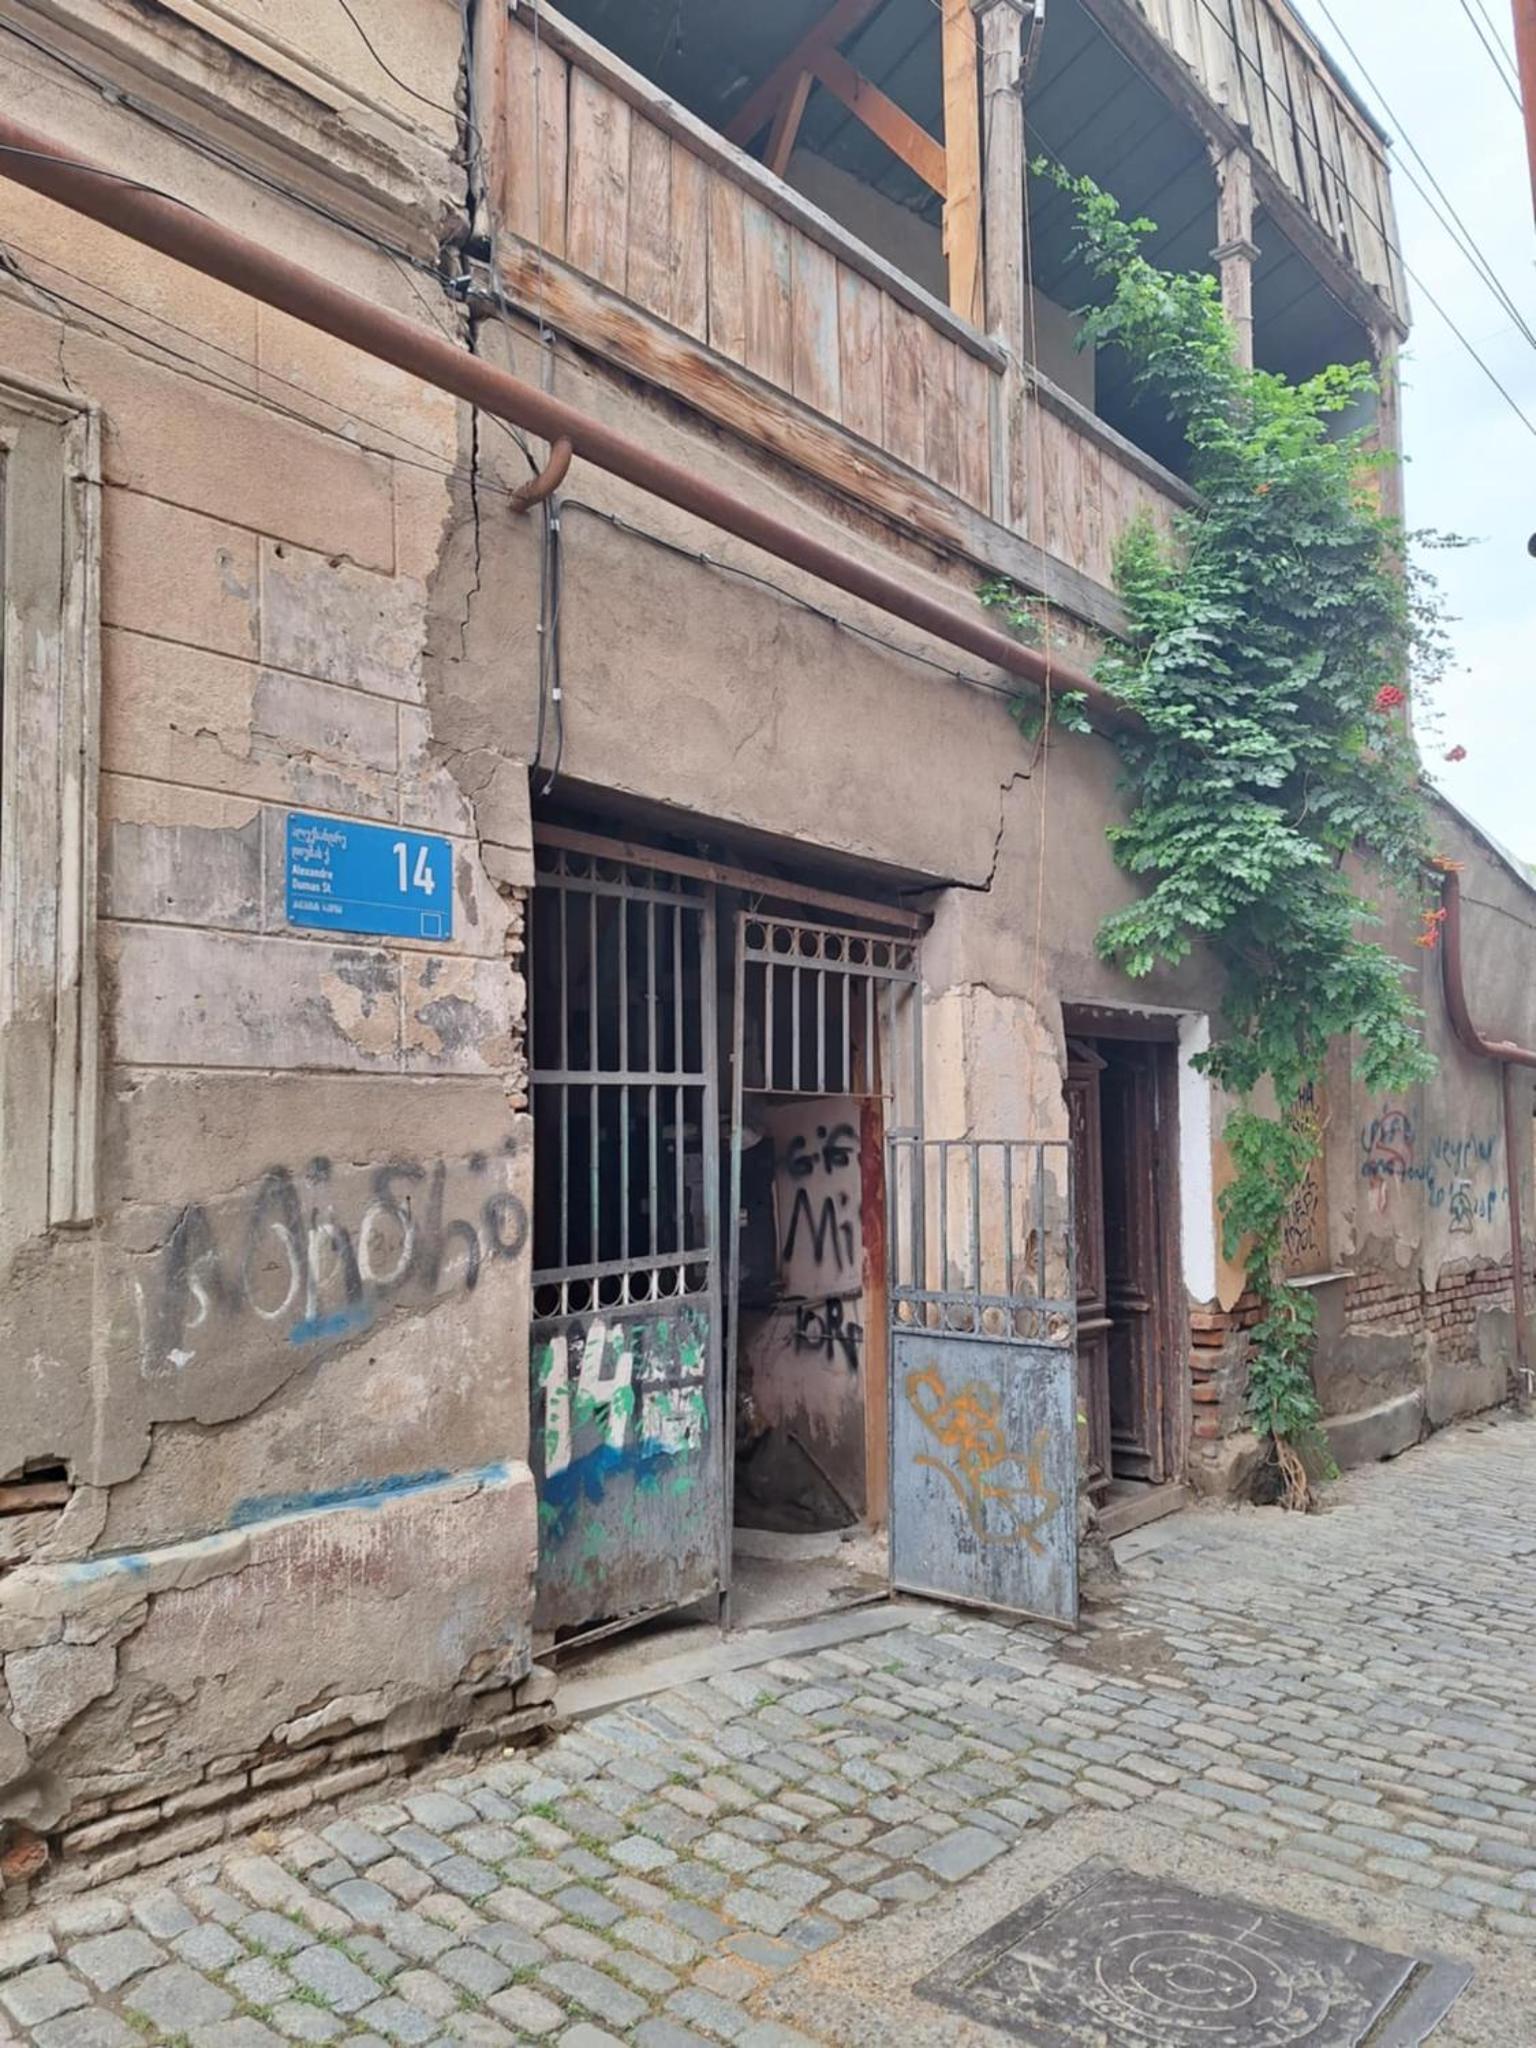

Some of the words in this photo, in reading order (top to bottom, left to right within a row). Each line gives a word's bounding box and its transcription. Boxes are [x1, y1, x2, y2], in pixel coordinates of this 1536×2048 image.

[291, 864, 333, 880] Alexandre
[393, 842, 435, 895] 14
[291, 878, 320, 892] Dumas
